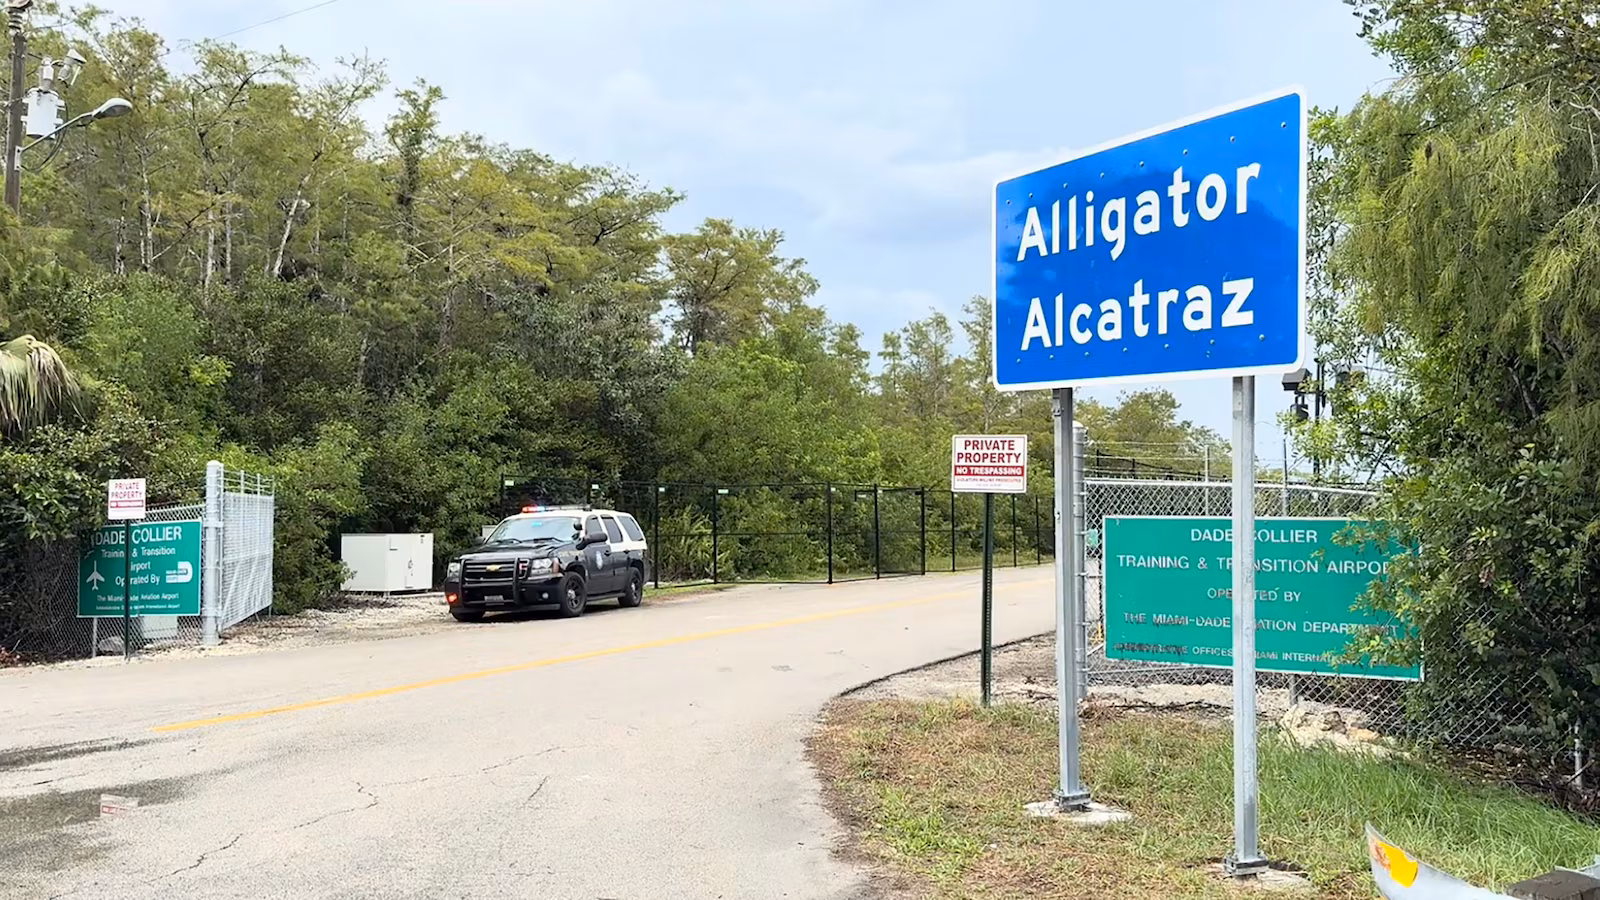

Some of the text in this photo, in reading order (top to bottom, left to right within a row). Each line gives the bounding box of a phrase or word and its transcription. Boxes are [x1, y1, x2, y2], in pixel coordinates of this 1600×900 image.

[1016, 162, 1261, 262] Alligator
[1020, 277, 1255, 351] Alcatraz
[964, 439, 1015, 451] PRIVATE
[957, 452, 1022, 464] PROPERTY
[956, 466, 1022, 476] NO TRESPASSING
[115, 482, 140, 490] PRIVATE
[111, 490, 143, 499] PROPERTY
[95, 526, 182, 546] DADE COLLIER
[1191, 528, 1318, 543] DADE OLLIER
[101, 546, 176, 558] Trainin & Transition
[130, 561, 151, 573] irport
[1116, 554, 1389, 575] TRAINING & TRNSITION AIRPOR
[115, 574, 149, 587] Oprated
[150, 573, 160, 586] By
[107, 594, 139, 602] Miami-ade
[1207, 587, 1302, 602] OPETED BY
[1124, 612, 1400, 637] THE MIAMI-DADE ATION DEPARNT
[1192, 646, 1233, 657] OFFICES
[1255, 650, 1279, 661] IAMI
[1282, 651, 1336, 663] INTERNAT
